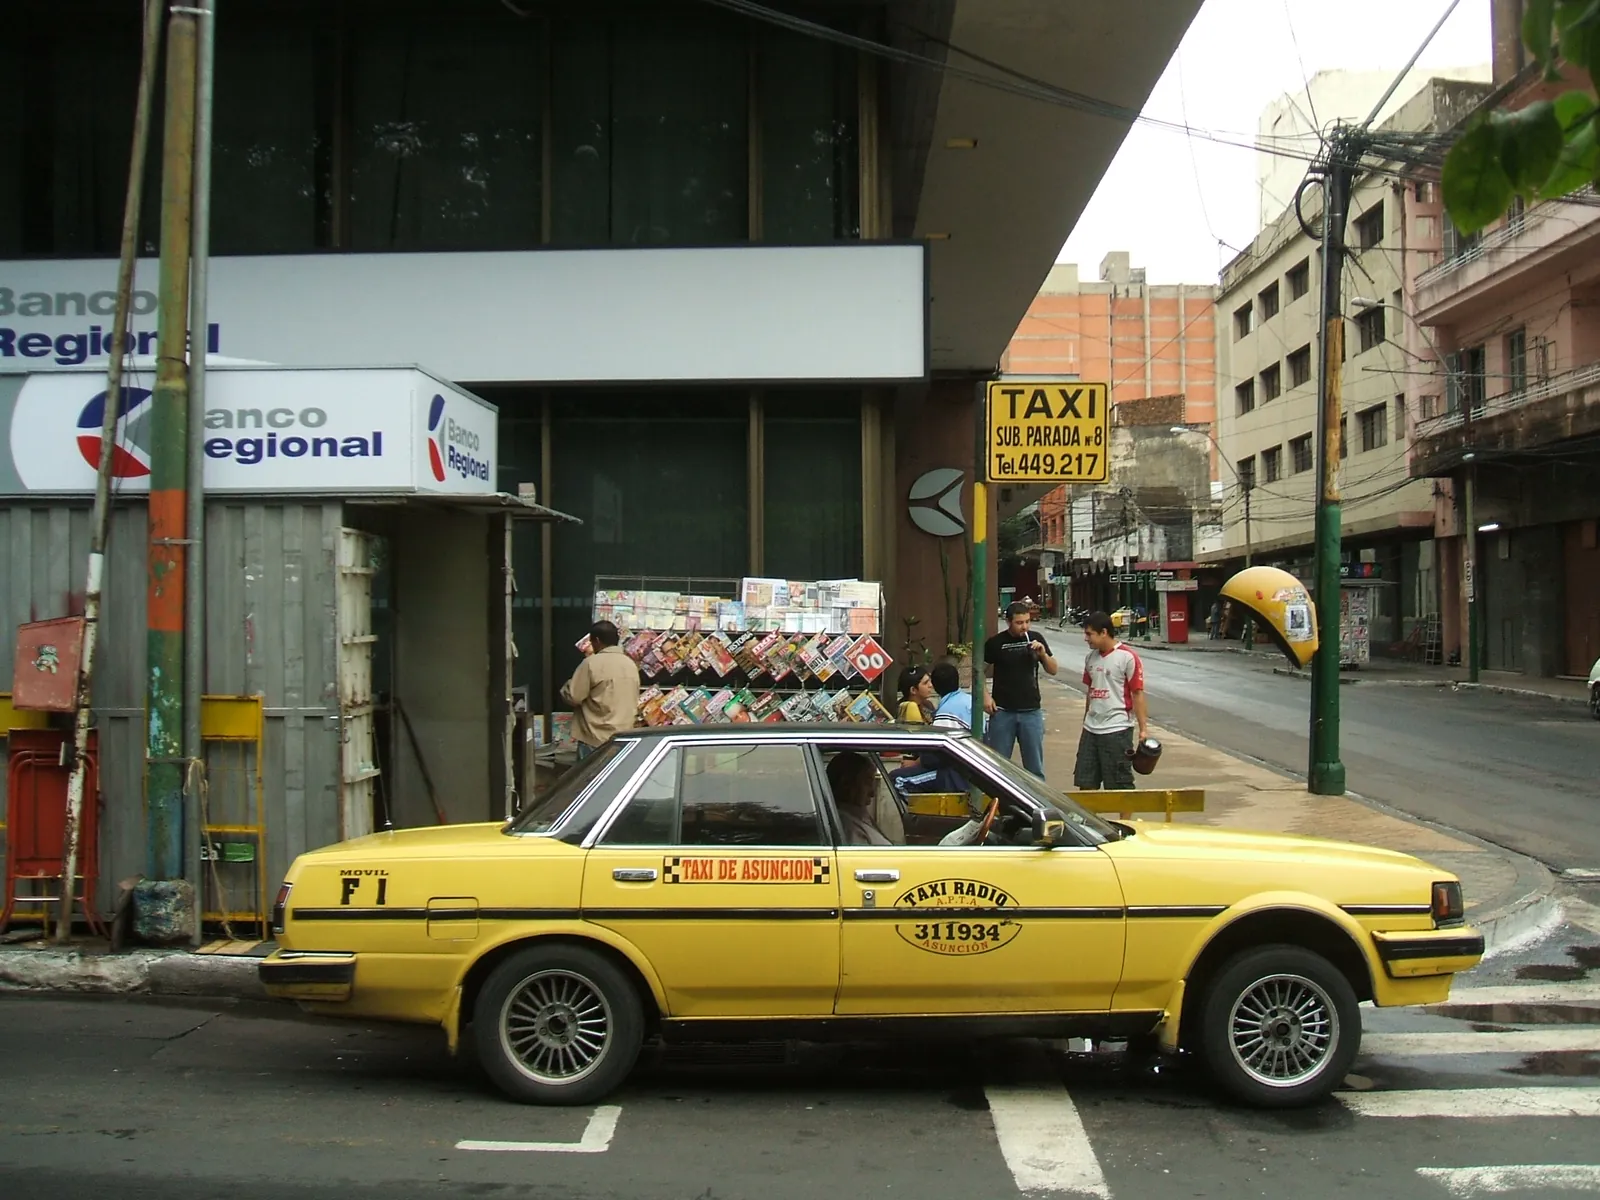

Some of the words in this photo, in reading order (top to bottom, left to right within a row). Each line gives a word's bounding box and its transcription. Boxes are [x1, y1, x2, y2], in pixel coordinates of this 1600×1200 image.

[1001, 389, 1096, 419] TAXI
[203, 407, 328, 429] anco
[448, 417, 480, 452] Banco
[996, 426, 1023, 446] SUB.
[1027, 426, 1081, 446] PARADA
[1094, 426, 1102, 446] 8
[203, 431, 382, 465] egional
[448, 444, 489, 481] Regional
[726, 631, 753, 654] HISTORIA
[682, 859, 714, 880] TAXI
[718, 860, 737, 880] DE
[741, 859, 813, 880] ASUNCION
[340, 878, 360, 905] F
[903, 882, 947, 907] TAXI
[953, 881, 1008, 907] RADIO
[914, 923, 1000, 941] 311934
[922, 940, 989, 953] ASUNCIÓN
